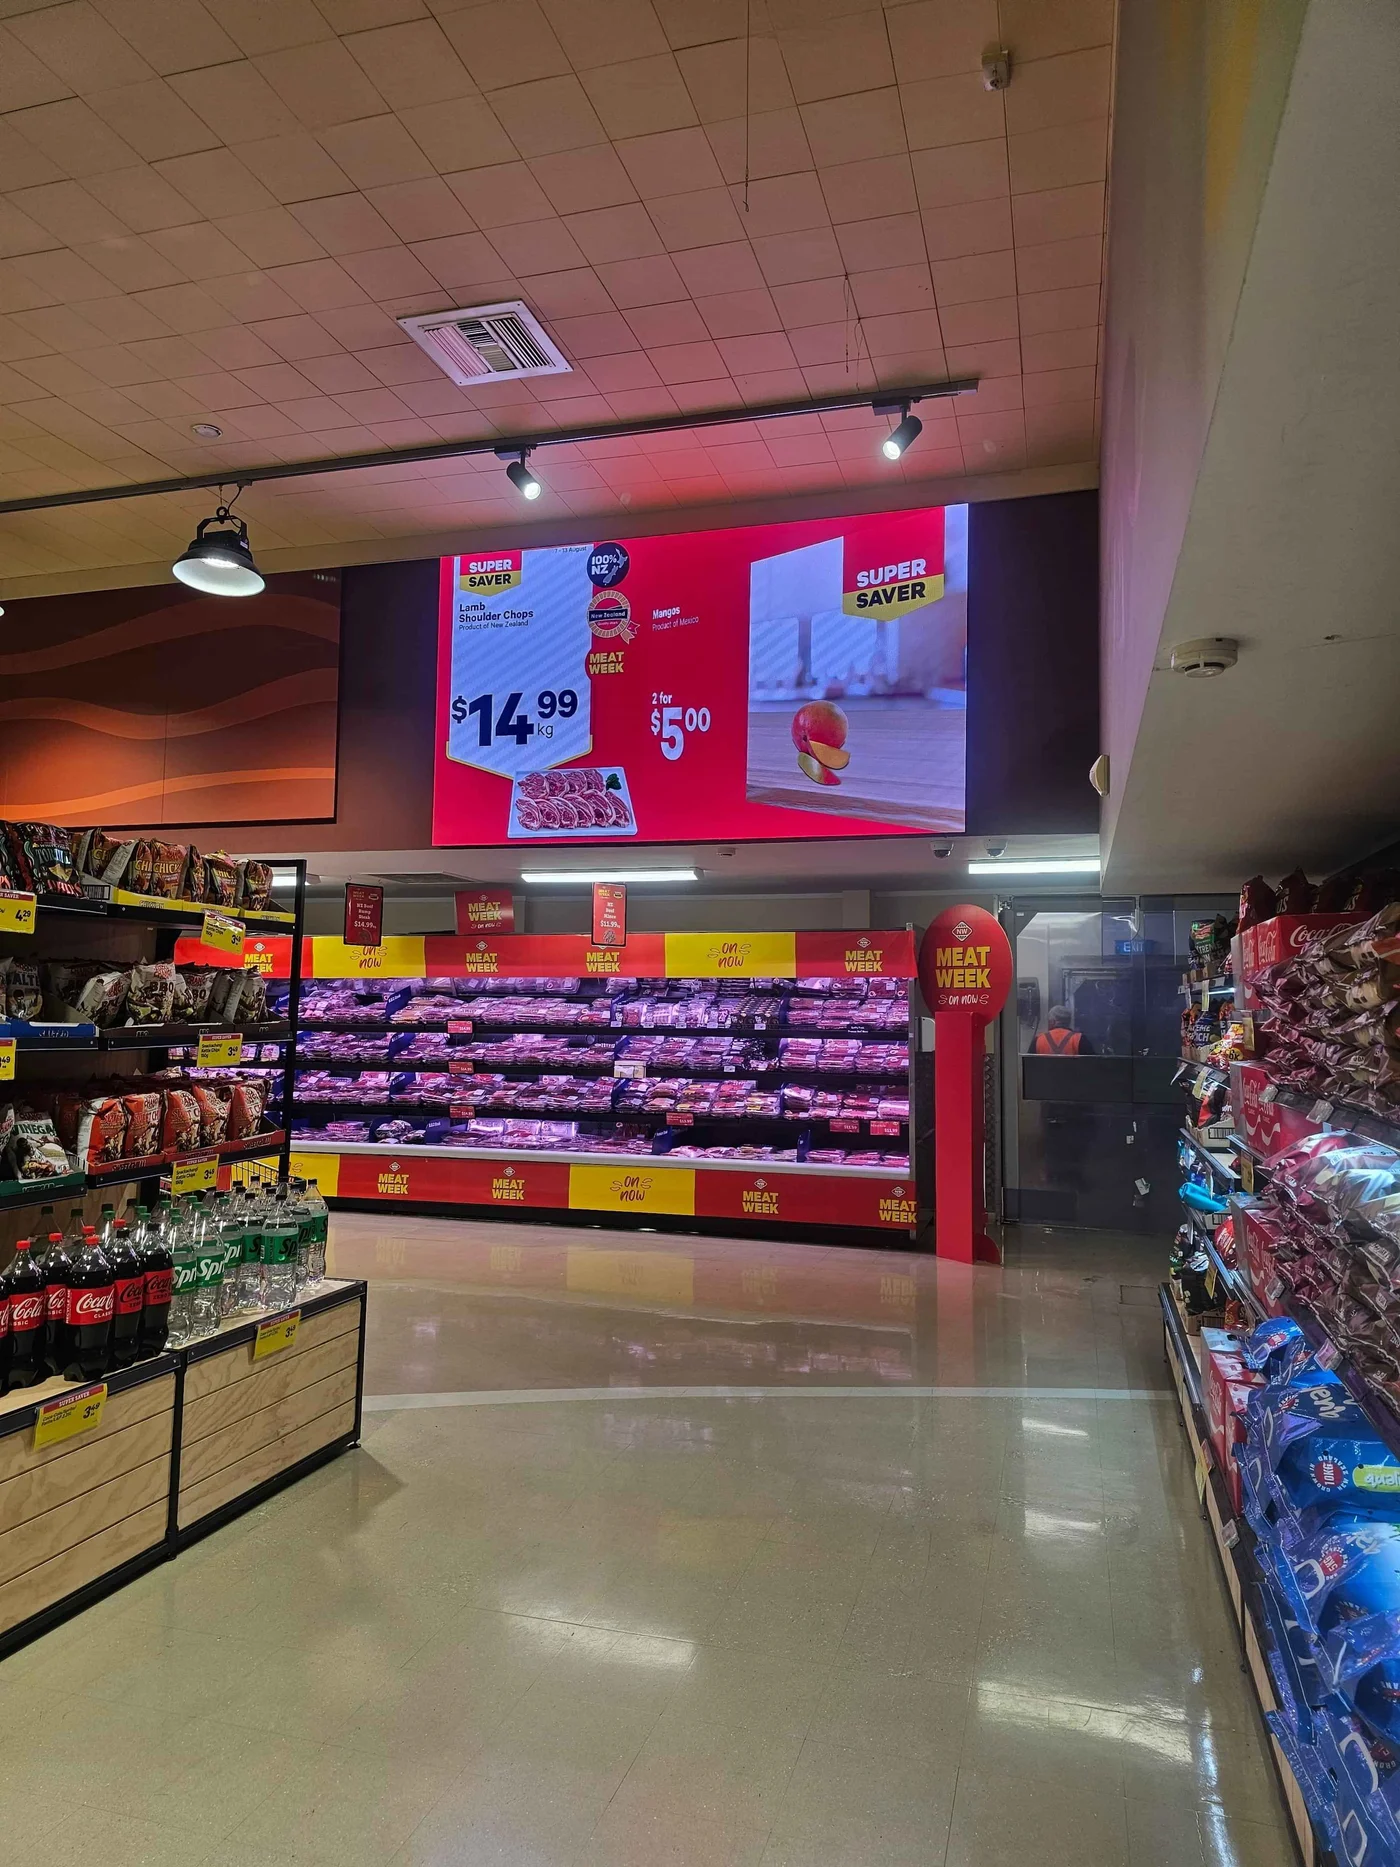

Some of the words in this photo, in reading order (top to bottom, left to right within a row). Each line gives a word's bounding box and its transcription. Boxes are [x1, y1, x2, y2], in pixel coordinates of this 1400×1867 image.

[591, 554, 617, 565] 100%
[468, 559, 513, 573] SUPER
[591, 565, 609, 575] NZ
[856, 558, 927, 588] SUPER
[468, 574, 512, 588] SAVER
[855, 581, 926, 609] SAVER
[459, 602, 486, 612] Lamb
[652, 606, 681, 620] Mangos
[459, 611, 501, 623] Shoulder
[503, 609, 534, 621] Chops
[505, 620, 529, 628] Zealand
[652, 621, 671, 632] Product
[672, 620, 679, 628] of
[679, 616, 699, 627] Mexico
[589, 651, 625, 663] MEAT
[588, 663, 624, 675] WEEK
[651, 692, 658, 705] 2
[659, 691, 673, 705] for
[537, 723, 554, 739] kg
[468, 901, 501, 911] MEAT
[468, 911, 502, 922] WEEK
[721, 942, 738, 954] on
[1123, 941, 1143, 952] EXIT
[244, 953, 273, 963] MEAT
[466, 952, 498, 962] MEAT
[586, 952, 620, 962] MEAT
[845, 950, 883, 961] MEAT
[936, 946, 991, 967] MEAT
[359, 957, 382, 969] now
[466, 962, 499, 973] WEEK
[586, 962, 620, 973] WEEK
[718, 956, 744, 968] now
[845, 961, 883, 972] WEEK
[935, 968, 991, 988] WEEK
[948, 995, 959, 1005] on
[961, 994, 979, 1004] now
[378, 1173, 410, 1184] MEAT
[492, 1178, 525, 1190] MEAT
[624, 1175, 640, 1188] on
[377, 1184, 409, 1195] WEEK
[492, 1189, 524, 1200] WEEK
[619, 1189, 645, 1202] now
[742, 1190, 779, 1202] MEAT
[742, 1202, 779, 1214] WEEK
[879, 1199, 917, 1212] MEAT
[878, 1210, 917, 1223] WEEK
[59, 1396, 75, 1407] SUPER
[75, 1391, 90, 1401] SAVER
[1323, 1462, 1335, 1486] 10KG
